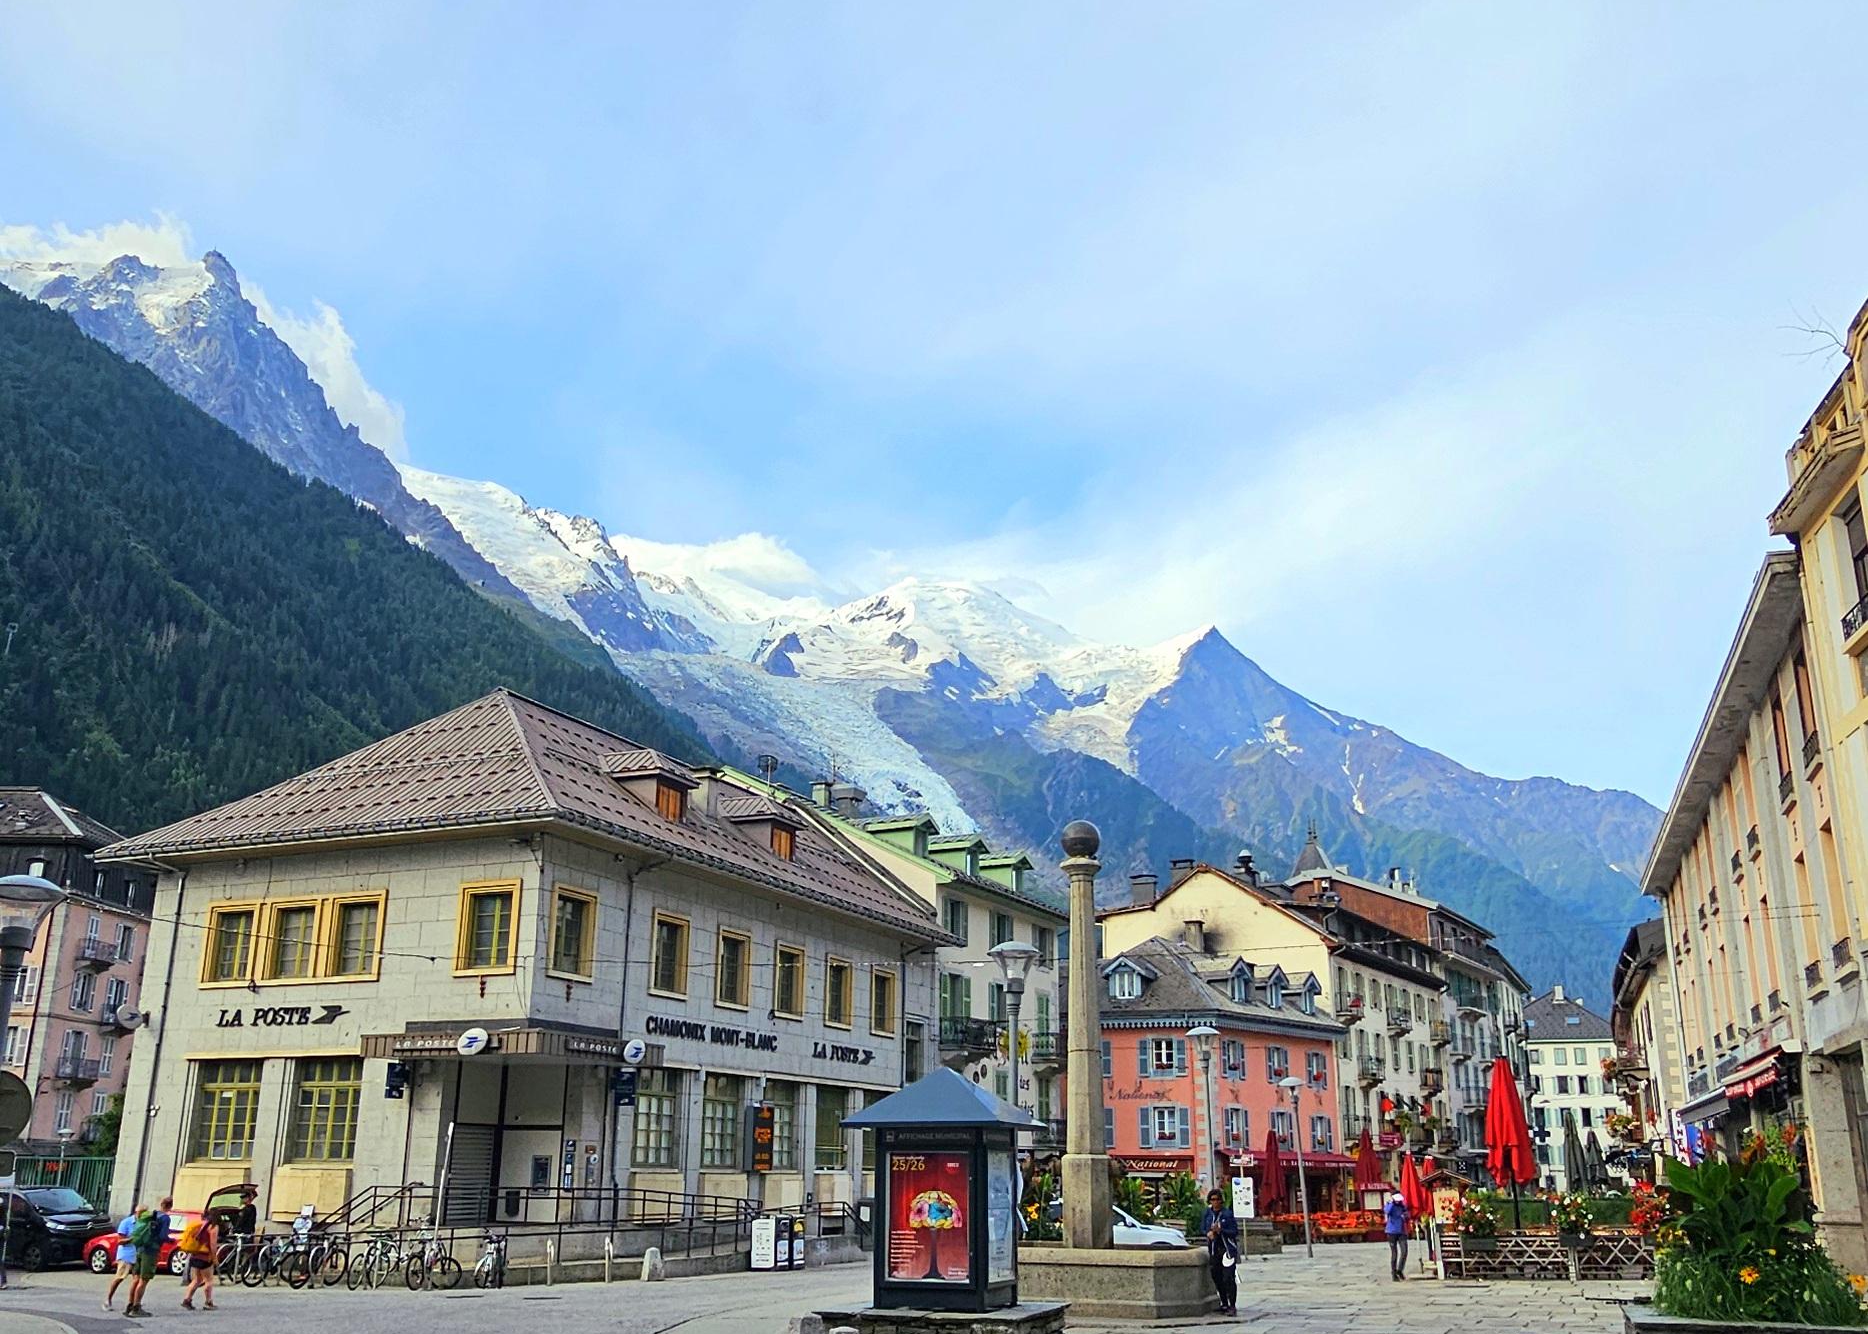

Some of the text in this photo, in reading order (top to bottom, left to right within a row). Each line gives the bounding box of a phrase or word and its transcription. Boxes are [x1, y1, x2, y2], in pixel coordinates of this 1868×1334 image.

[216, 1006, 312, 1027] LA POSTE
[645, 1015, 778, 1052] CHAMONIX MONT-BLANC
[417, 1039, 456, 1048] POSTE
[589, 1043, 617, 1054] POSTE
[812, 1042, 860, 1064] LA POSTE
[892, 1159, 925, 1172] 25/26
[1126, 1159, 1178, 1170] National
